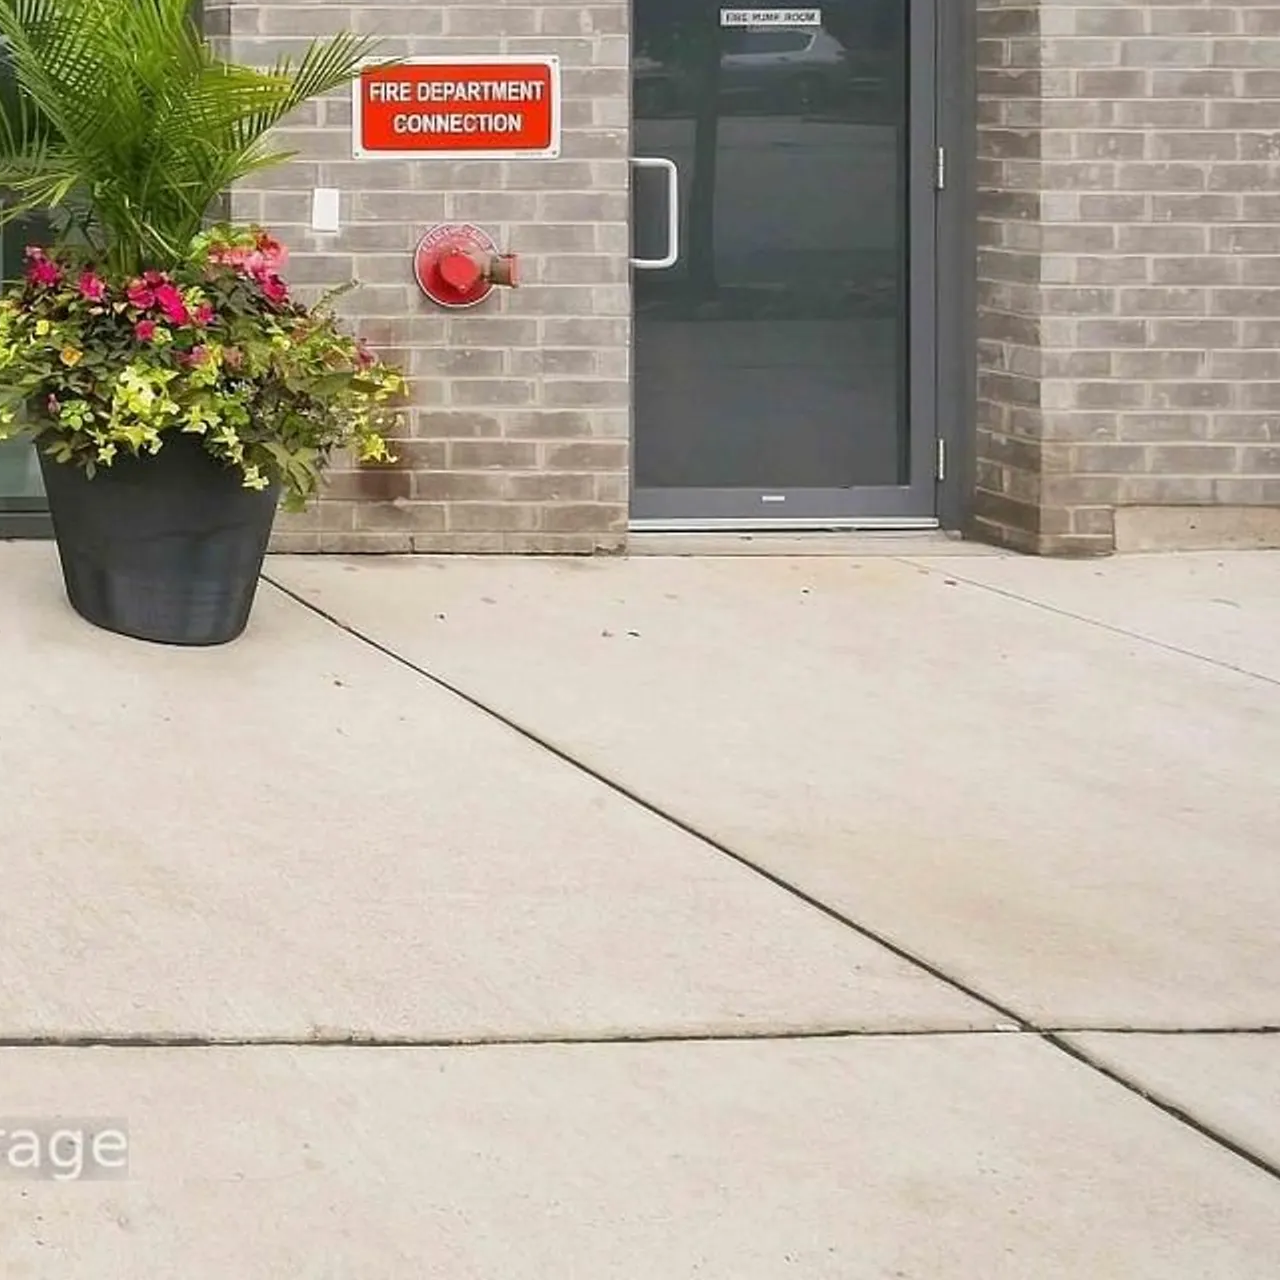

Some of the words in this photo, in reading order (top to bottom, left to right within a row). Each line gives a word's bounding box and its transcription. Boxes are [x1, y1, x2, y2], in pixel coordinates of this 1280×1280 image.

[369, 81, 411, 102] FIRE
[417, 80, 544, 102] DEPARTMENT
[393, 113, 522, 133] CONNECTION
